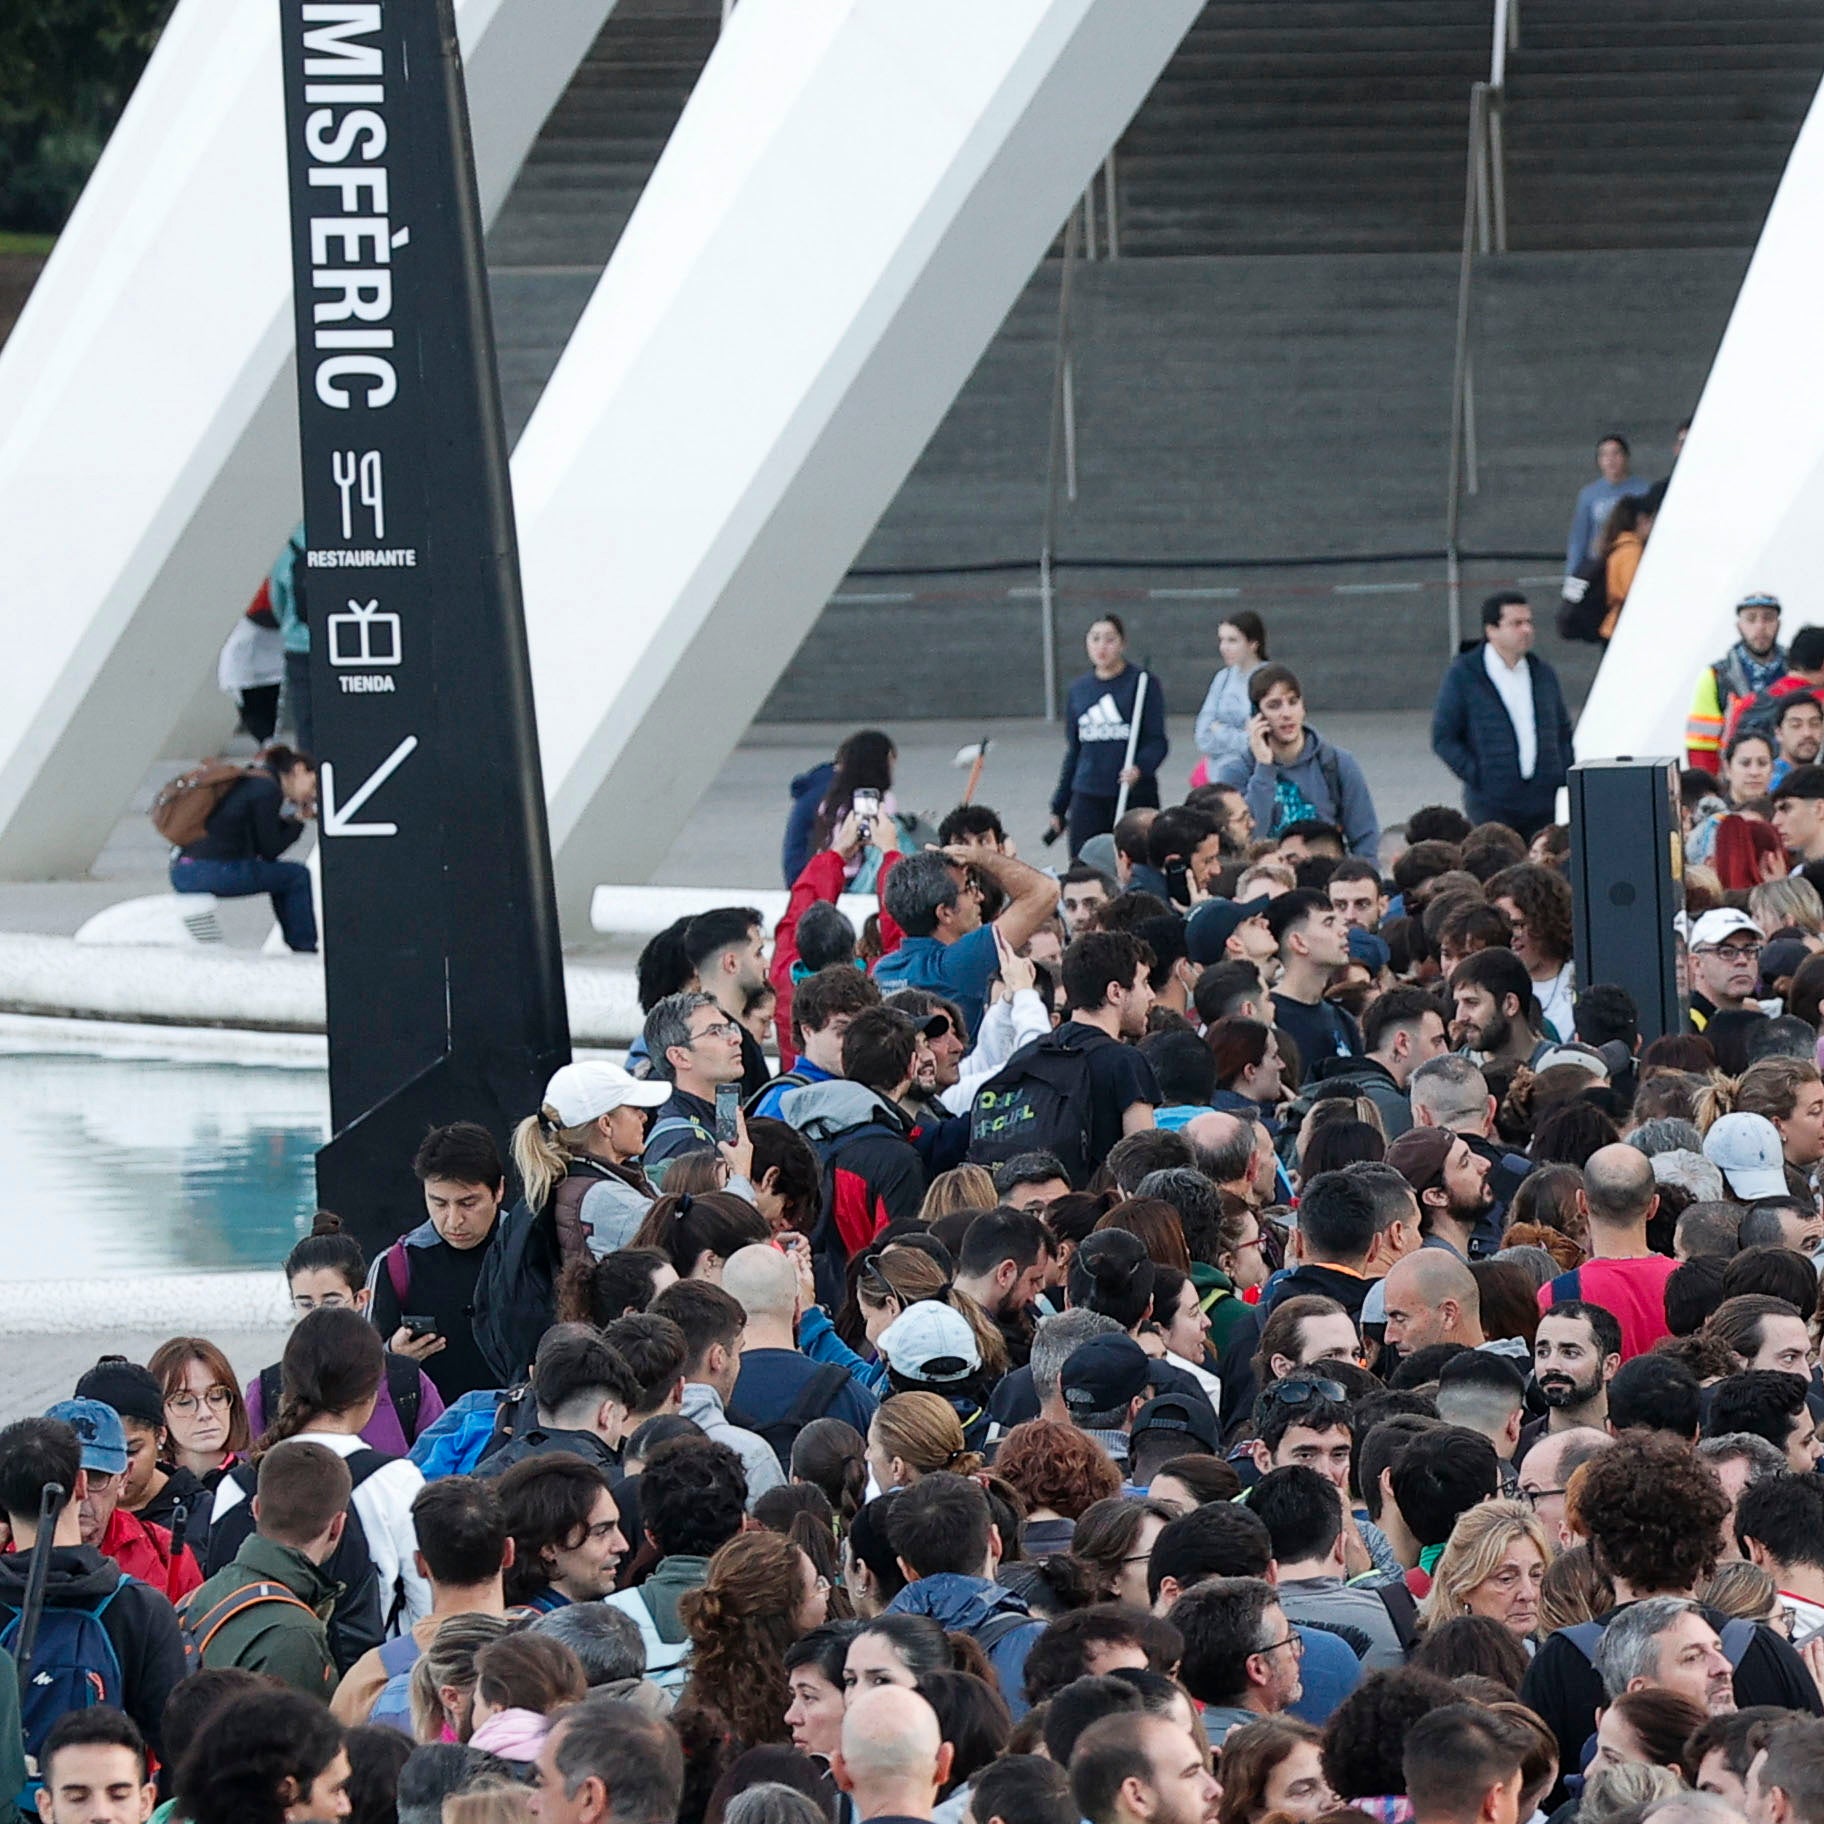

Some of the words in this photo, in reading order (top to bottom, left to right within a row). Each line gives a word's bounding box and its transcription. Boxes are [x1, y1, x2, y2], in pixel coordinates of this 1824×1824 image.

[302, 4, 409, 409] MISFÈRIC
[307, 549, 416, 568] RESTAURANTE
[338, 675, 396, 693] TIENDA
